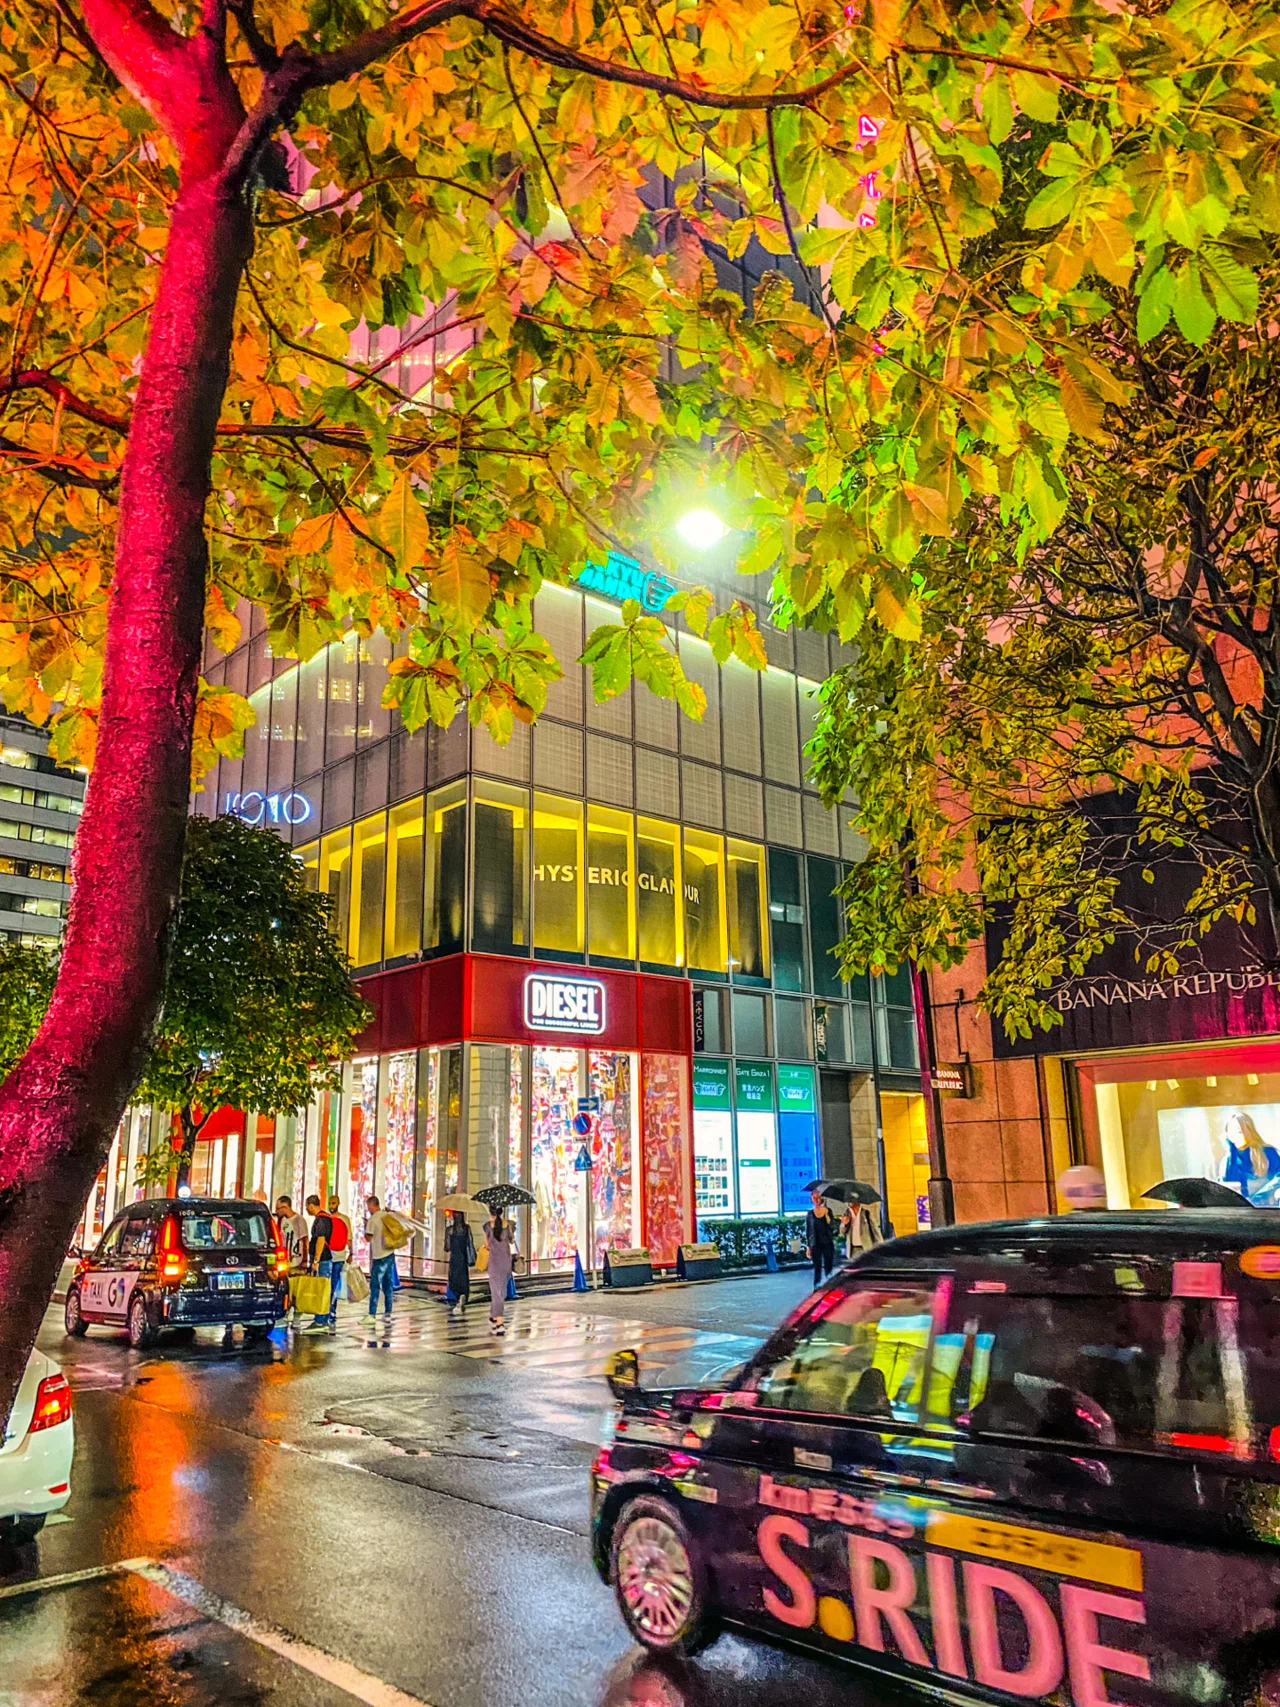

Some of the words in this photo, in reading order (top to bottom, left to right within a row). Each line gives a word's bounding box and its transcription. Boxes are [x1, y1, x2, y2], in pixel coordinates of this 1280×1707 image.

[531, 981, 599, 1022] DIESEL
[1057, 980, 1168, 1011] BANANA
[695, 1000, 703, 1043] KEYUCA
[756, 1514, 1151, 1707] S.RIDE
